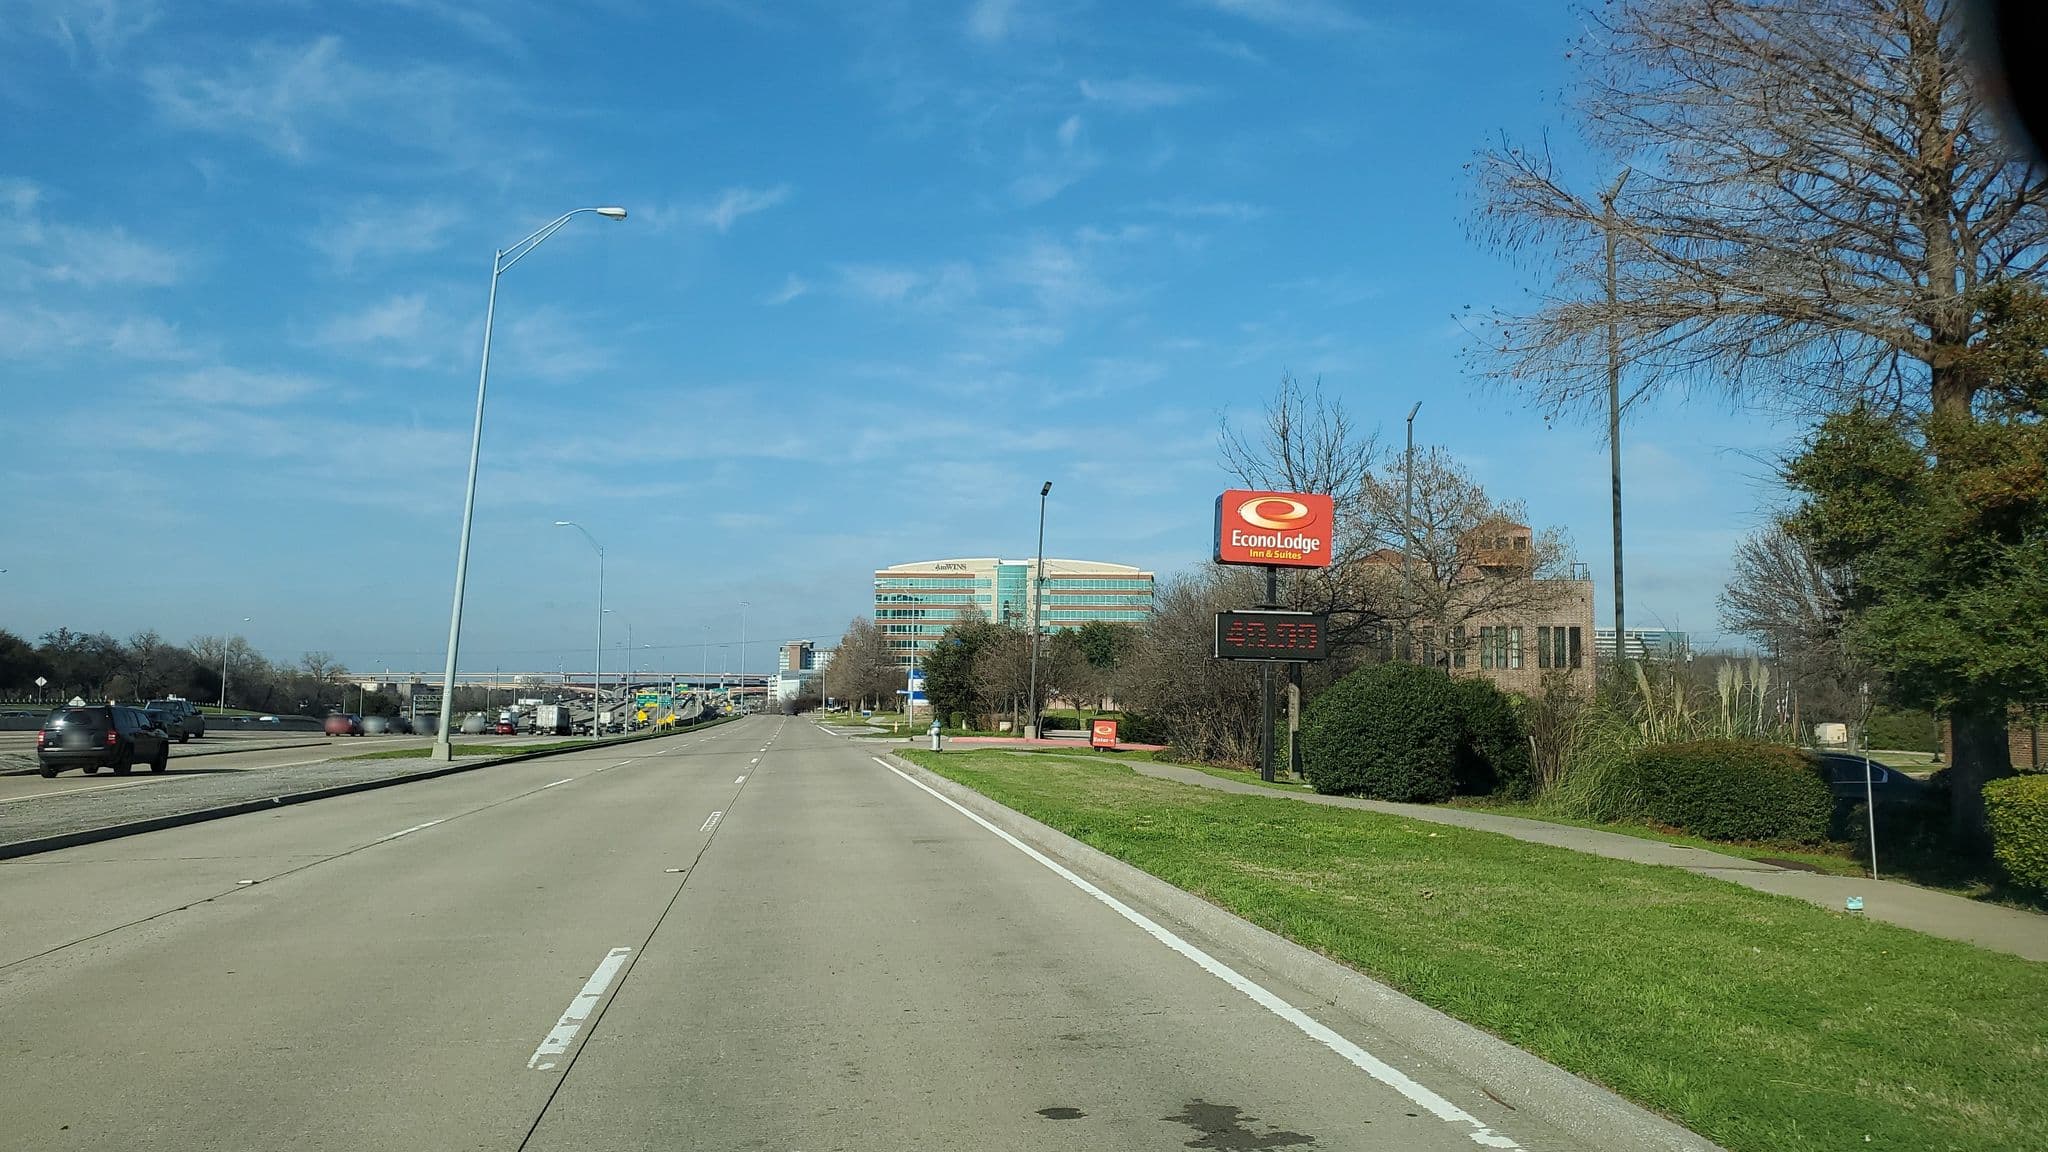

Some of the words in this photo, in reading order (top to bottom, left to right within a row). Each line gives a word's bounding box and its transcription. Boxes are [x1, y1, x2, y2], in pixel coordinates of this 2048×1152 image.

[1232, 529, 1320, 553] EconoLodge
[1249, 549, 1264, 558] Inn
[1266, 550, 1273, 558] &
[1274, 550, 1302, 560] Suites
